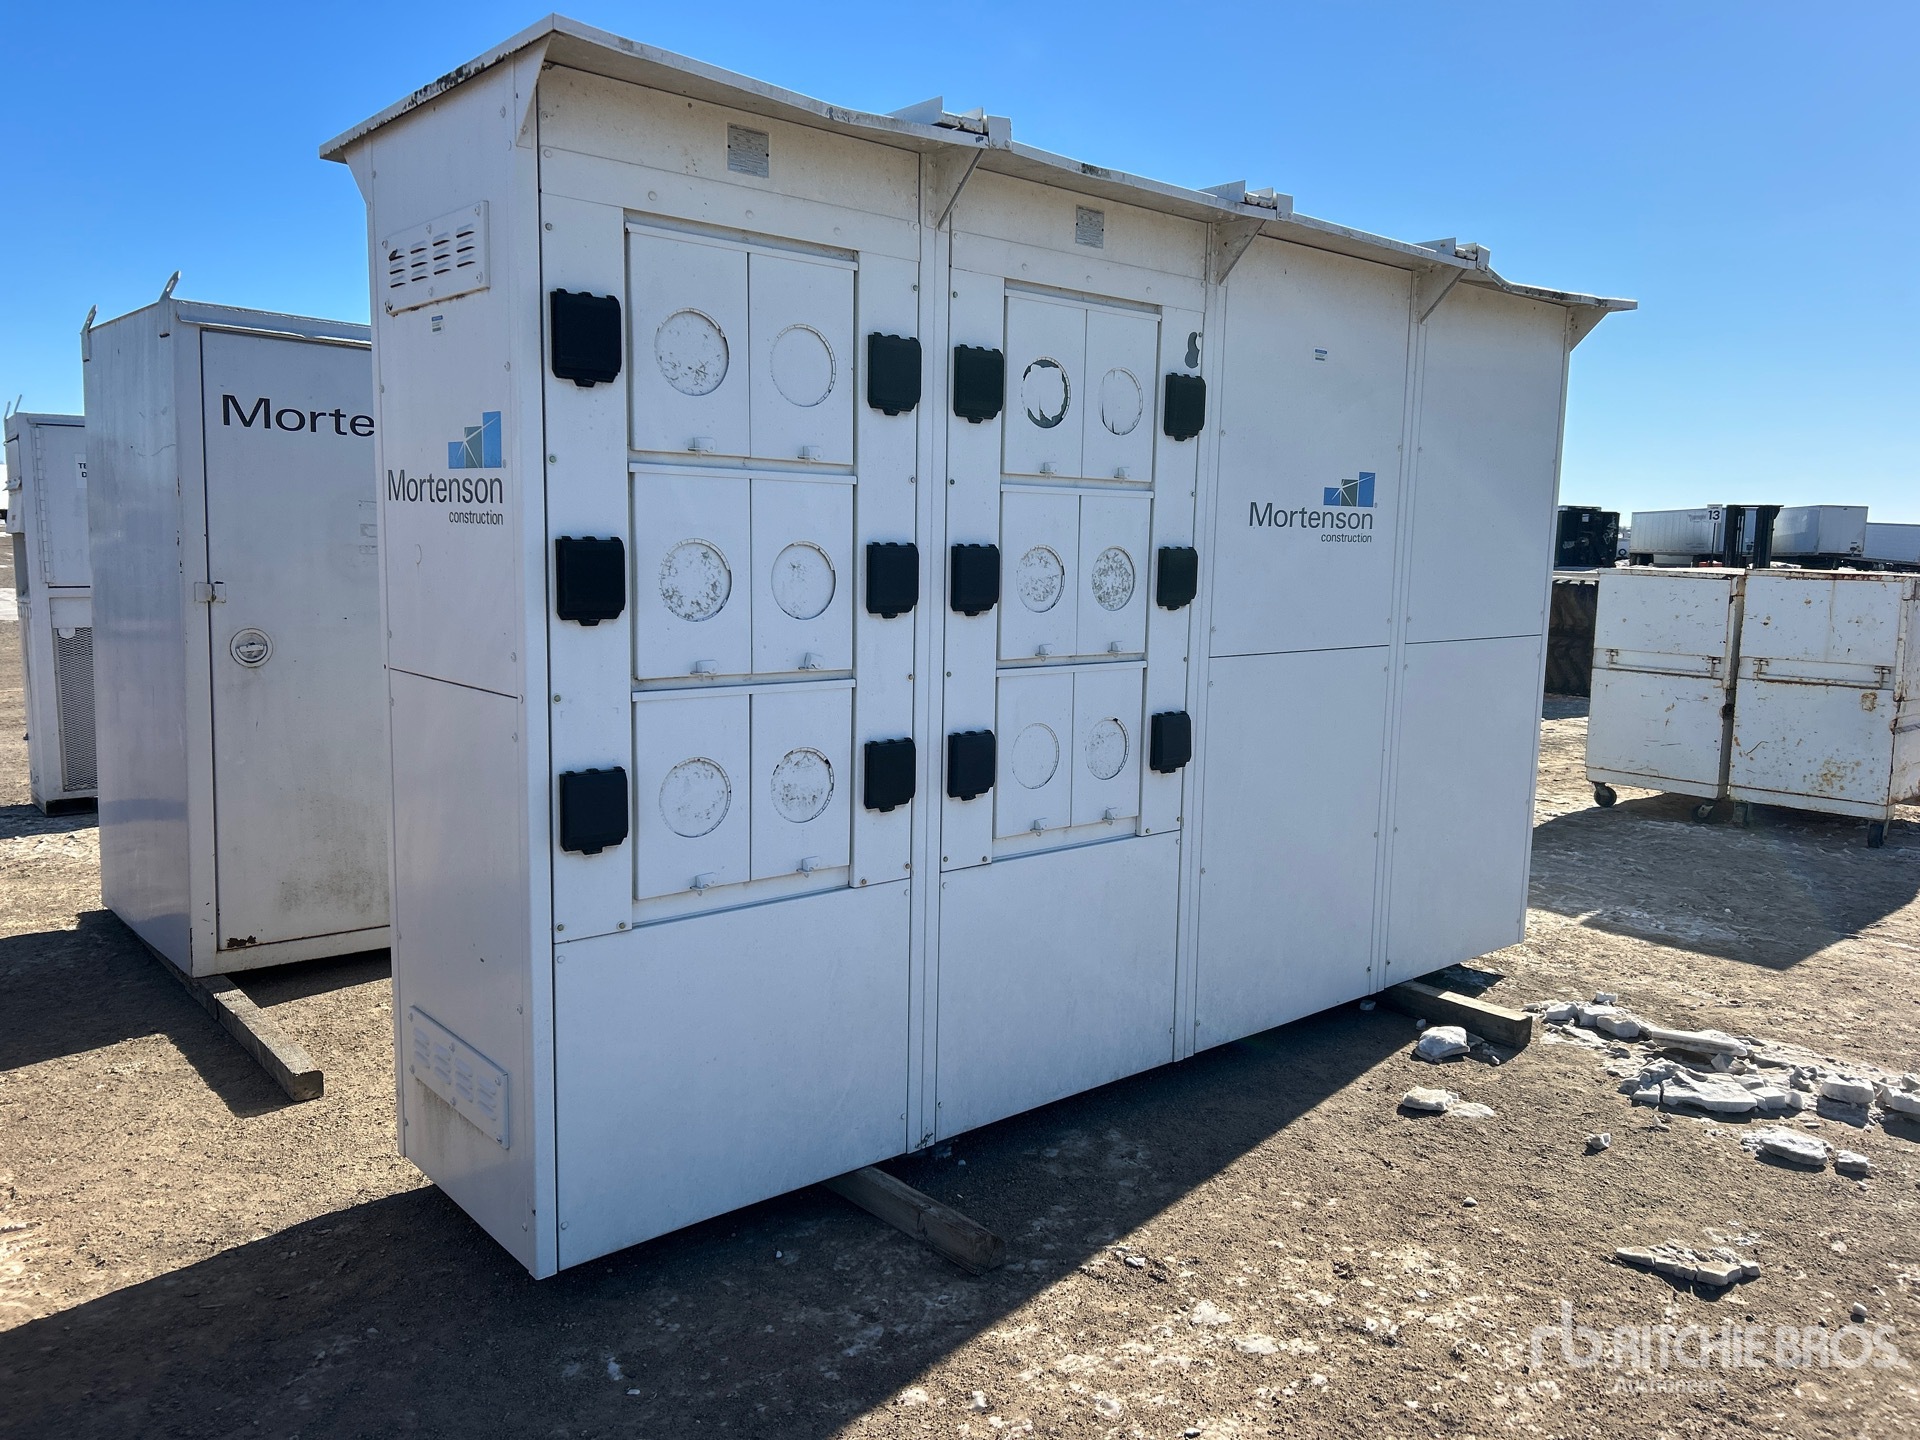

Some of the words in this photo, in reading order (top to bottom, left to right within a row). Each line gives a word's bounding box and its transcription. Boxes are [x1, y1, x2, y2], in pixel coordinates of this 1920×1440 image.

[222, 394, 375, 437] Morte
[387, 469, 503, 504] Mortenson
[448, 510, 504, 525] construction
[1249, 502, 1373, 529] Mortenson
[1707, 510, 1721, 521] 13
[1321, 532, 1372, 543] construction
